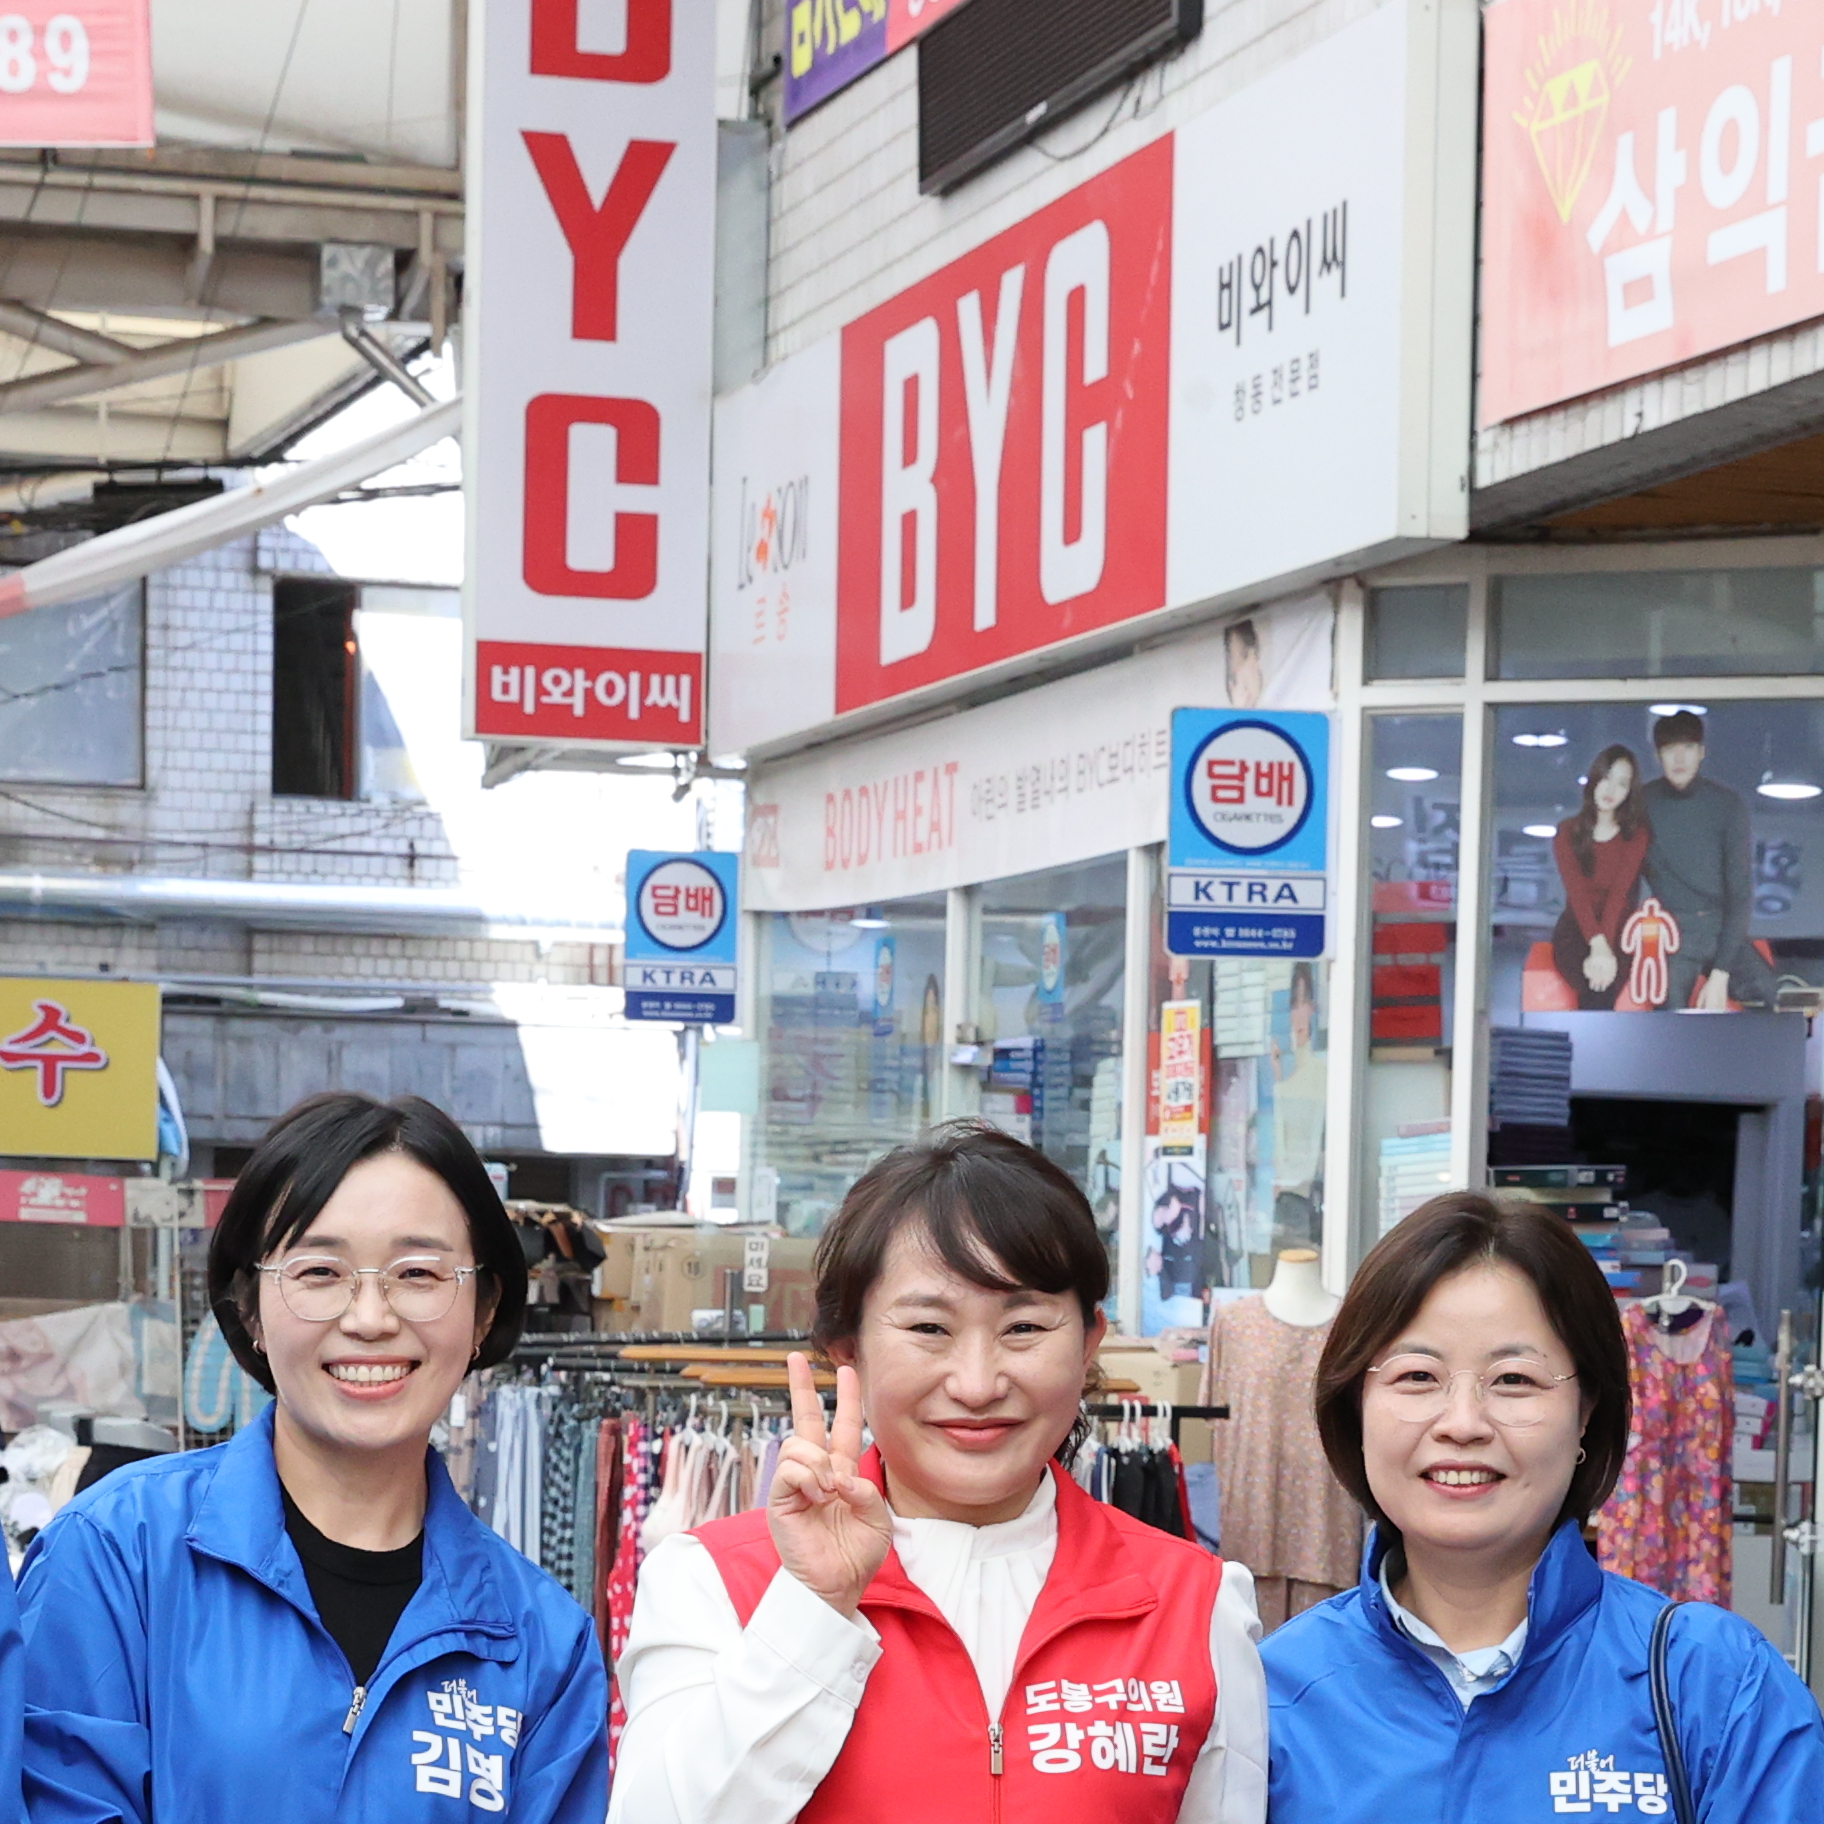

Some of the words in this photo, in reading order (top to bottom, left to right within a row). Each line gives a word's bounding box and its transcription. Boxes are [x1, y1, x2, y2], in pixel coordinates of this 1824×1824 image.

[1217, 198, 1348, 348] 비와이씨
[878, 217, 1112, 668] BYC
[488, 662, 691, 721] 비와이씨
[1206, 758, 1296, 808] 담배
[650, 883, 715, 919] 담배
[1193, 880, 1300, 905] KTRA
[642, 968, 717, 987] KTRA
[427, 1689, 524, 1750] 민주당
[1024, 1679, 1185, 1716] 도봉구의원
[410, 1730, 509, 1814] 김명
[1026, 1721, 1181, 1778] 강혜란
[1566, 1749, 1616, 1775] 더불어
[1548, 1769, 1669, 1814] 민주당
